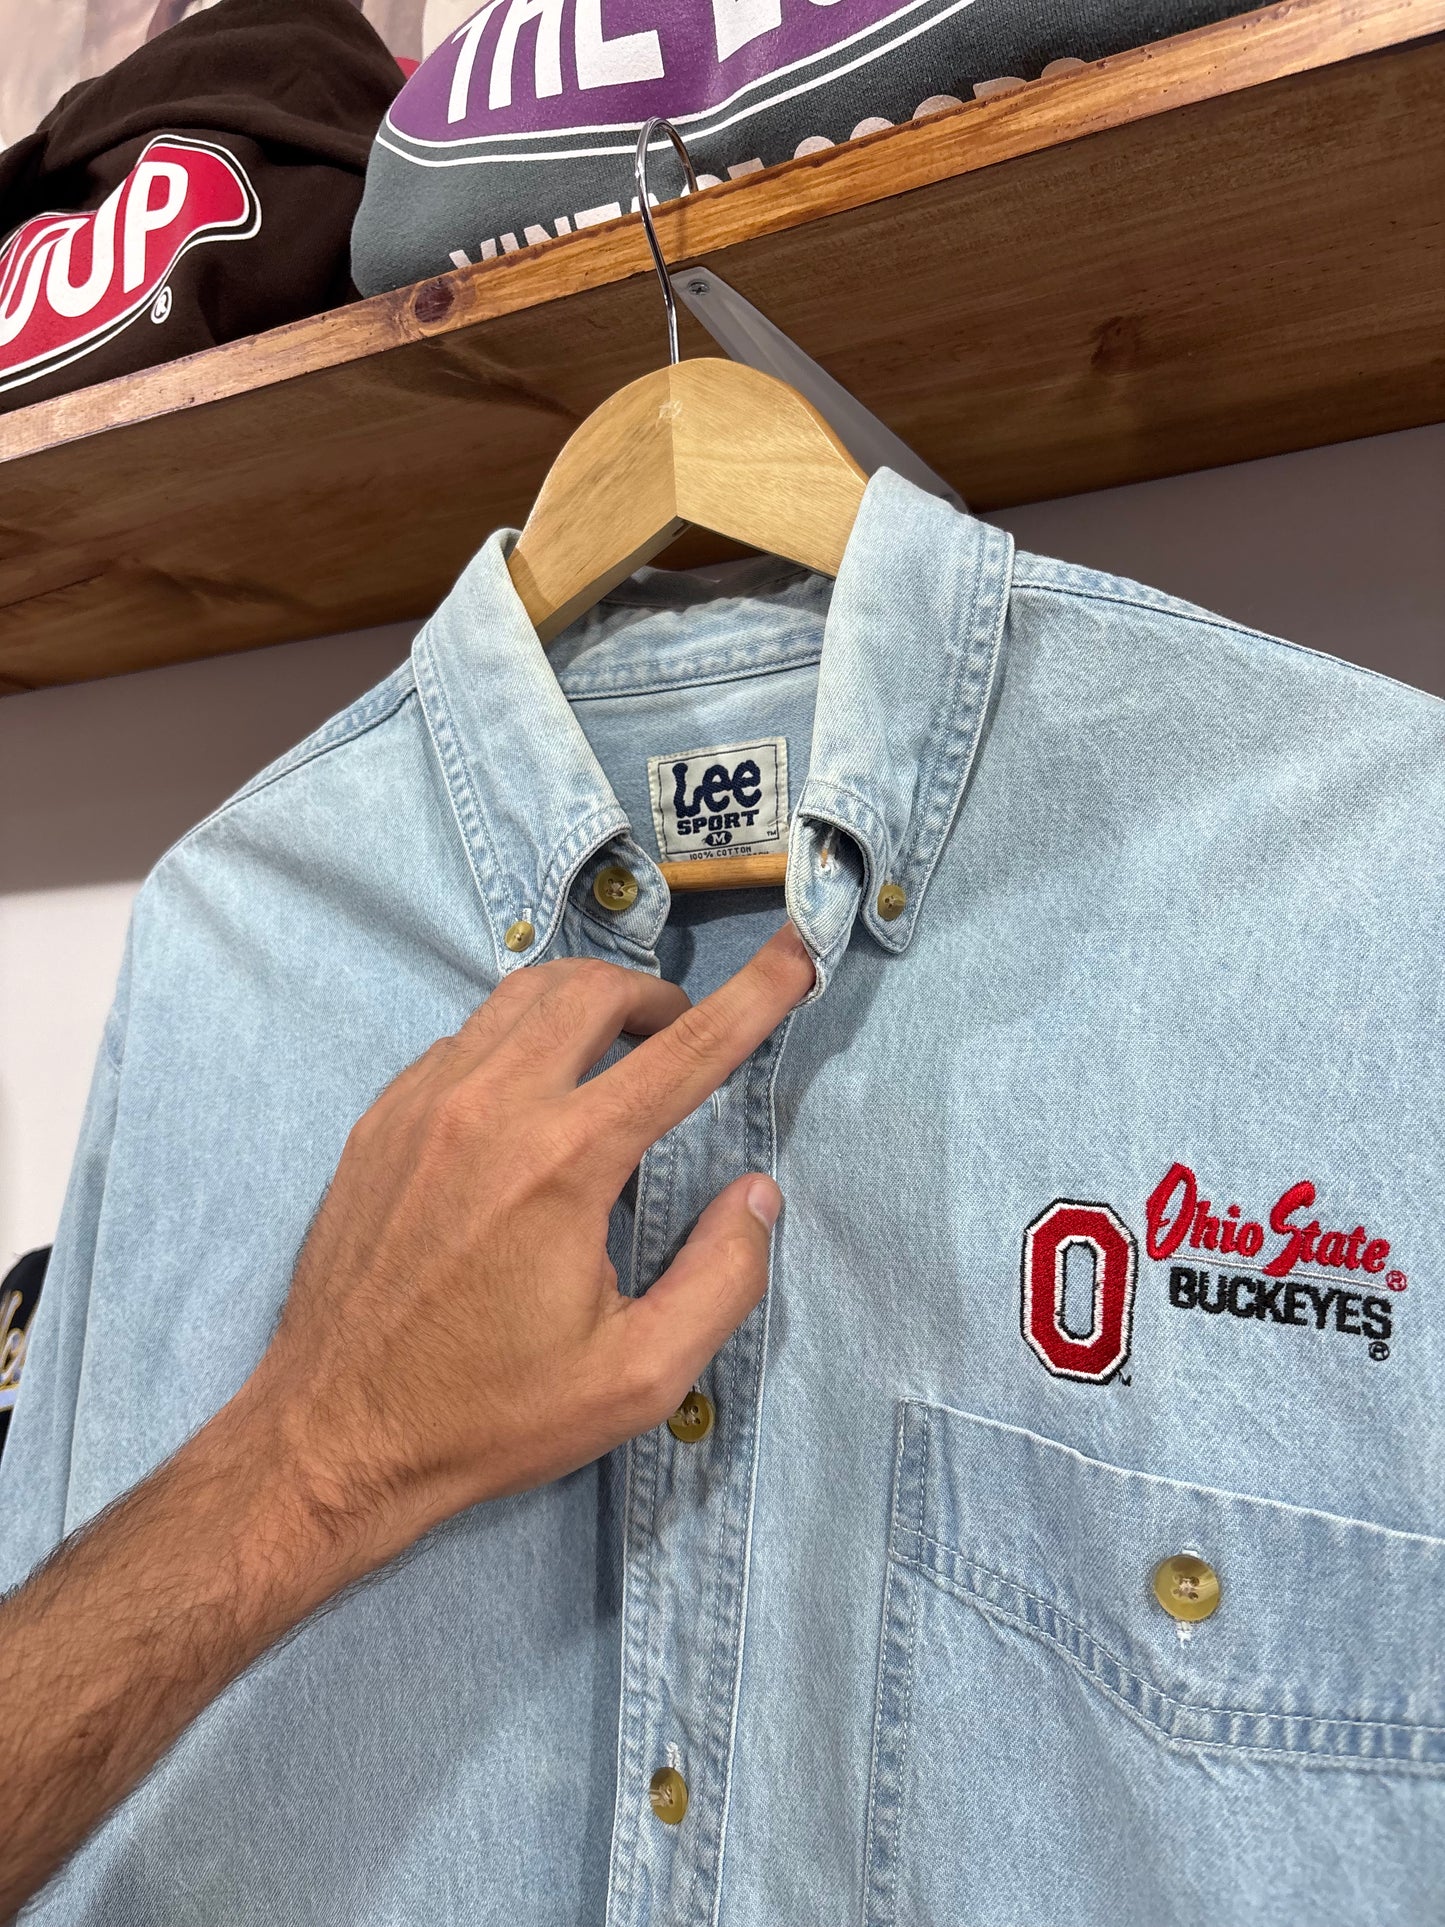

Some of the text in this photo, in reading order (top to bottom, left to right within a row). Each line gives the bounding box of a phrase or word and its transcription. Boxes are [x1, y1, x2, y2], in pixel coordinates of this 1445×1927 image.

[672, 759, 762, 818] Lee
[676, 809, 760, 836] SPORT
[689, 850, 714, 861] 100%
[716, 845, 752, 857] COTTON
[1145, 1162, 1264, 1262] Ohio
[1262, 1180, 1391, 1277] State
[1168, 1266, 1393, 1341] BUCKEYES
